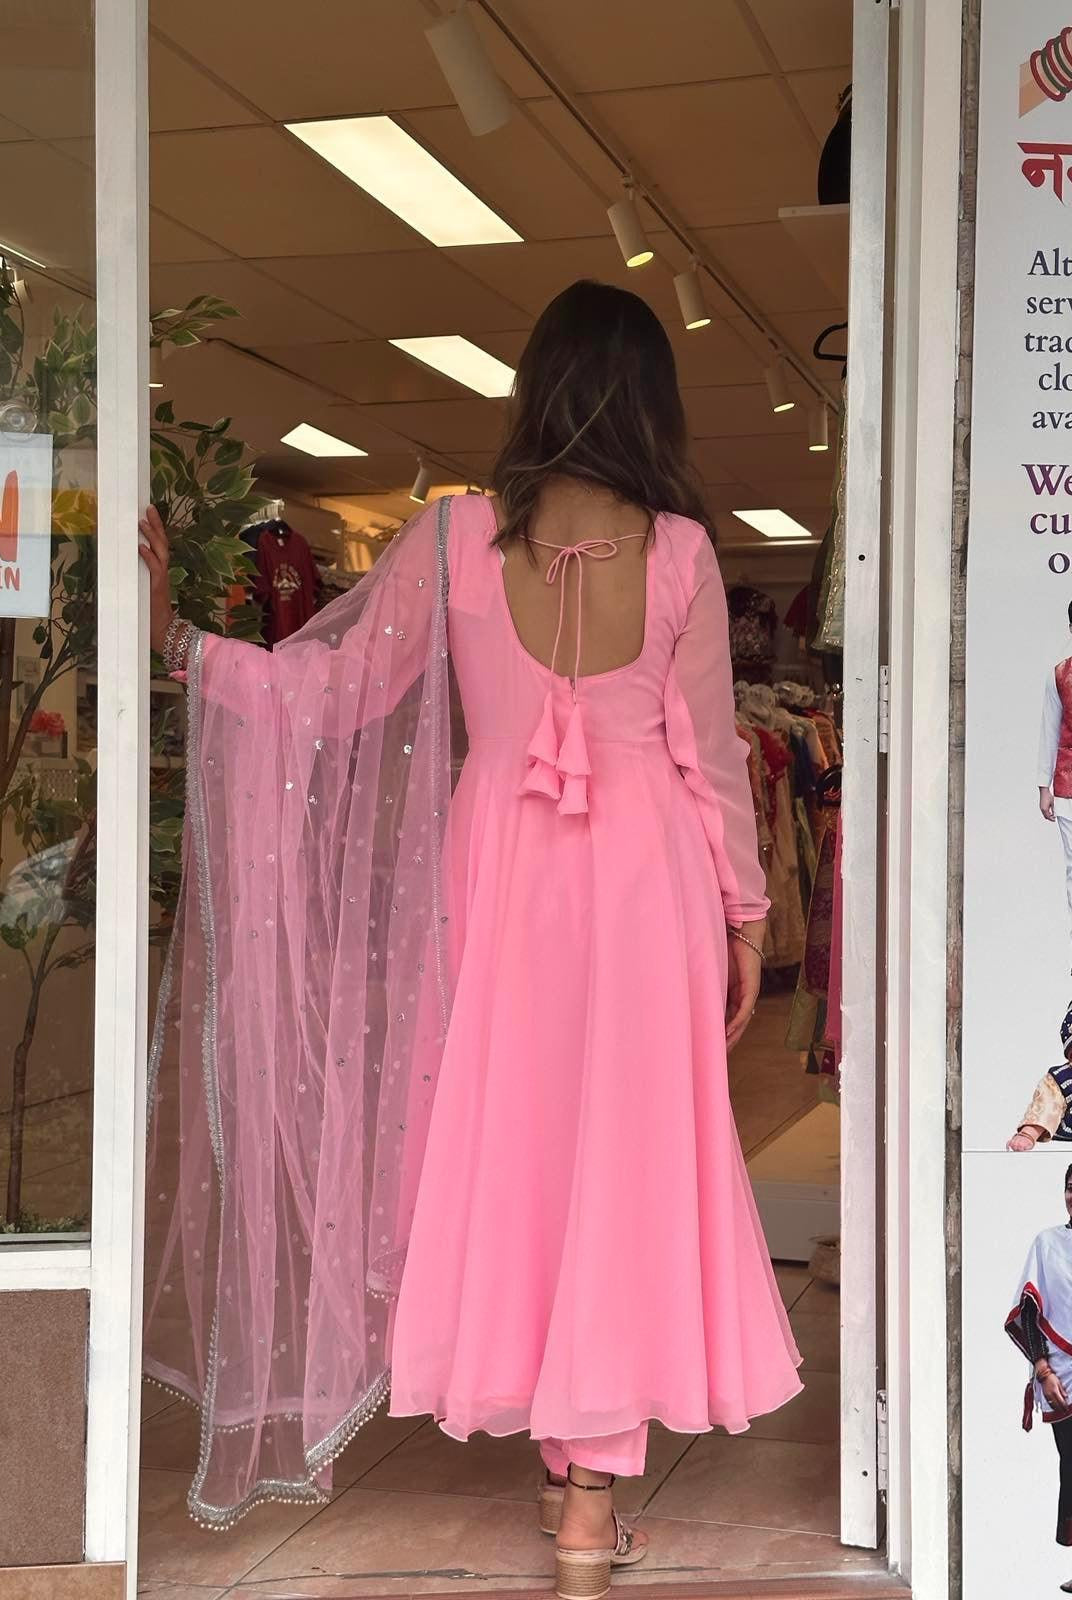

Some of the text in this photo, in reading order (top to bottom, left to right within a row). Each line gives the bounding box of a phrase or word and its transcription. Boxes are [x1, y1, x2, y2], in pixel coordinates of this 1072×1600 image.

[1017, 142, 1072, 206] न
[1027, 247, 1072, 276] Alt
[1030, 513, 1072, 535] cu
